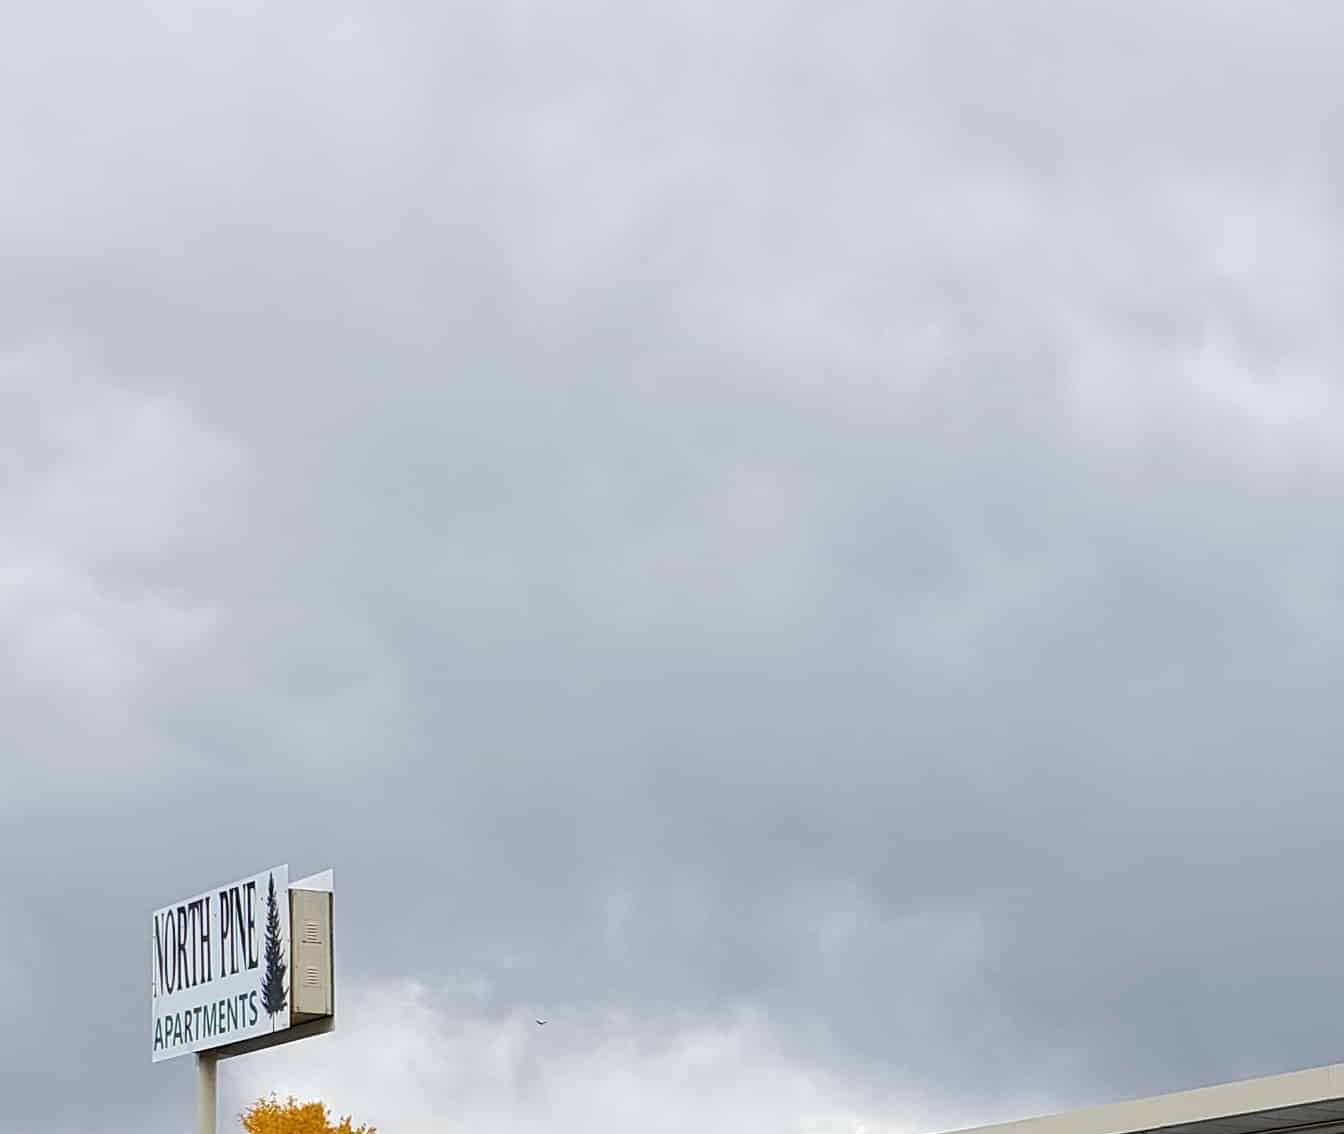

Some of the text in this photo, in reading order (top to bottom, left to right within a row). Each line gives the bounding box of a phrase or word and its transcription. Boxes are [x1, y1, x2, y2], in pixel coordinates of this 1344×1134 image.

[153, 880, 259, 998] NORTH PINE
[153, 990, 259, 1051] APARTMENTS
